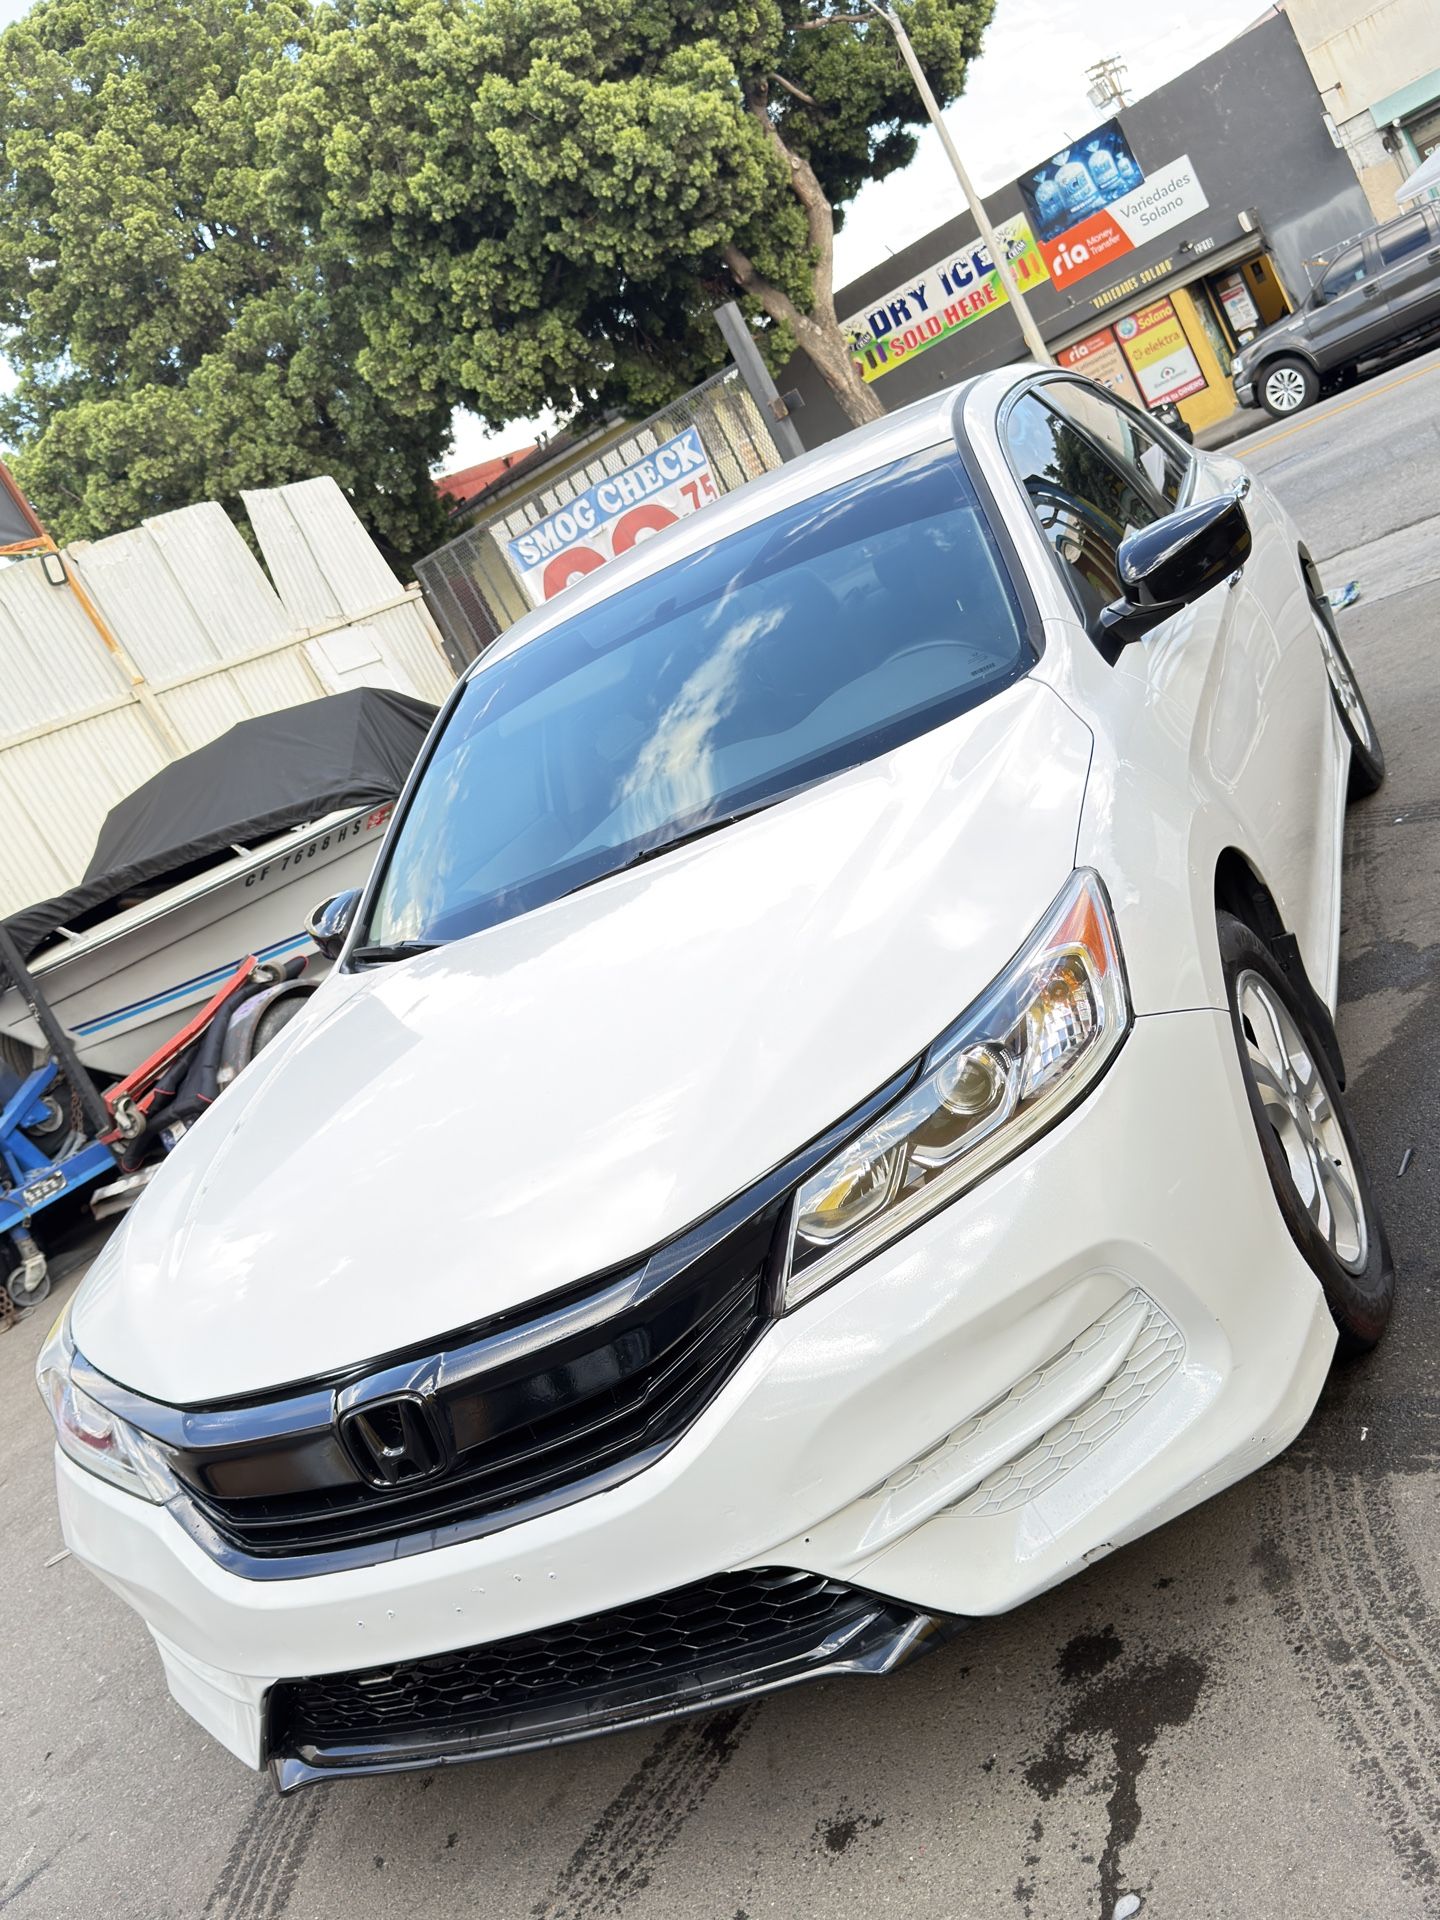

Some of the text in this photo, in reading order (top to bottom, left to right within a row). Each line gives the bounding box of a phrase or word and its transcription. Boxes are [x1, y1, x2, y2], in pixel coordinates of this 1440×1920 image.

[1120, 173, 1191, 219] Variedades
[1139, 196, 1184, 227] Solano
[1086, 227, 1114, 248] Money
[1089, 234, 1121, 256] Transfer
[1052, 242, 1090, 276] ria
[864, 242, 996, 339] DRY ICE
[888, 282, 998, 358] SOLD HERE
[1138, 306, 1173, 331] Solano
[1068, 344, 1089, 363] ria
[1145, 331, 1181, 357] elektra
[517, 497, 597, 566] SMOG
[596, 435, 704, 515] CHECK
[244, 866, 271, 888] CF
[281, 836, 331, 872] 7688
